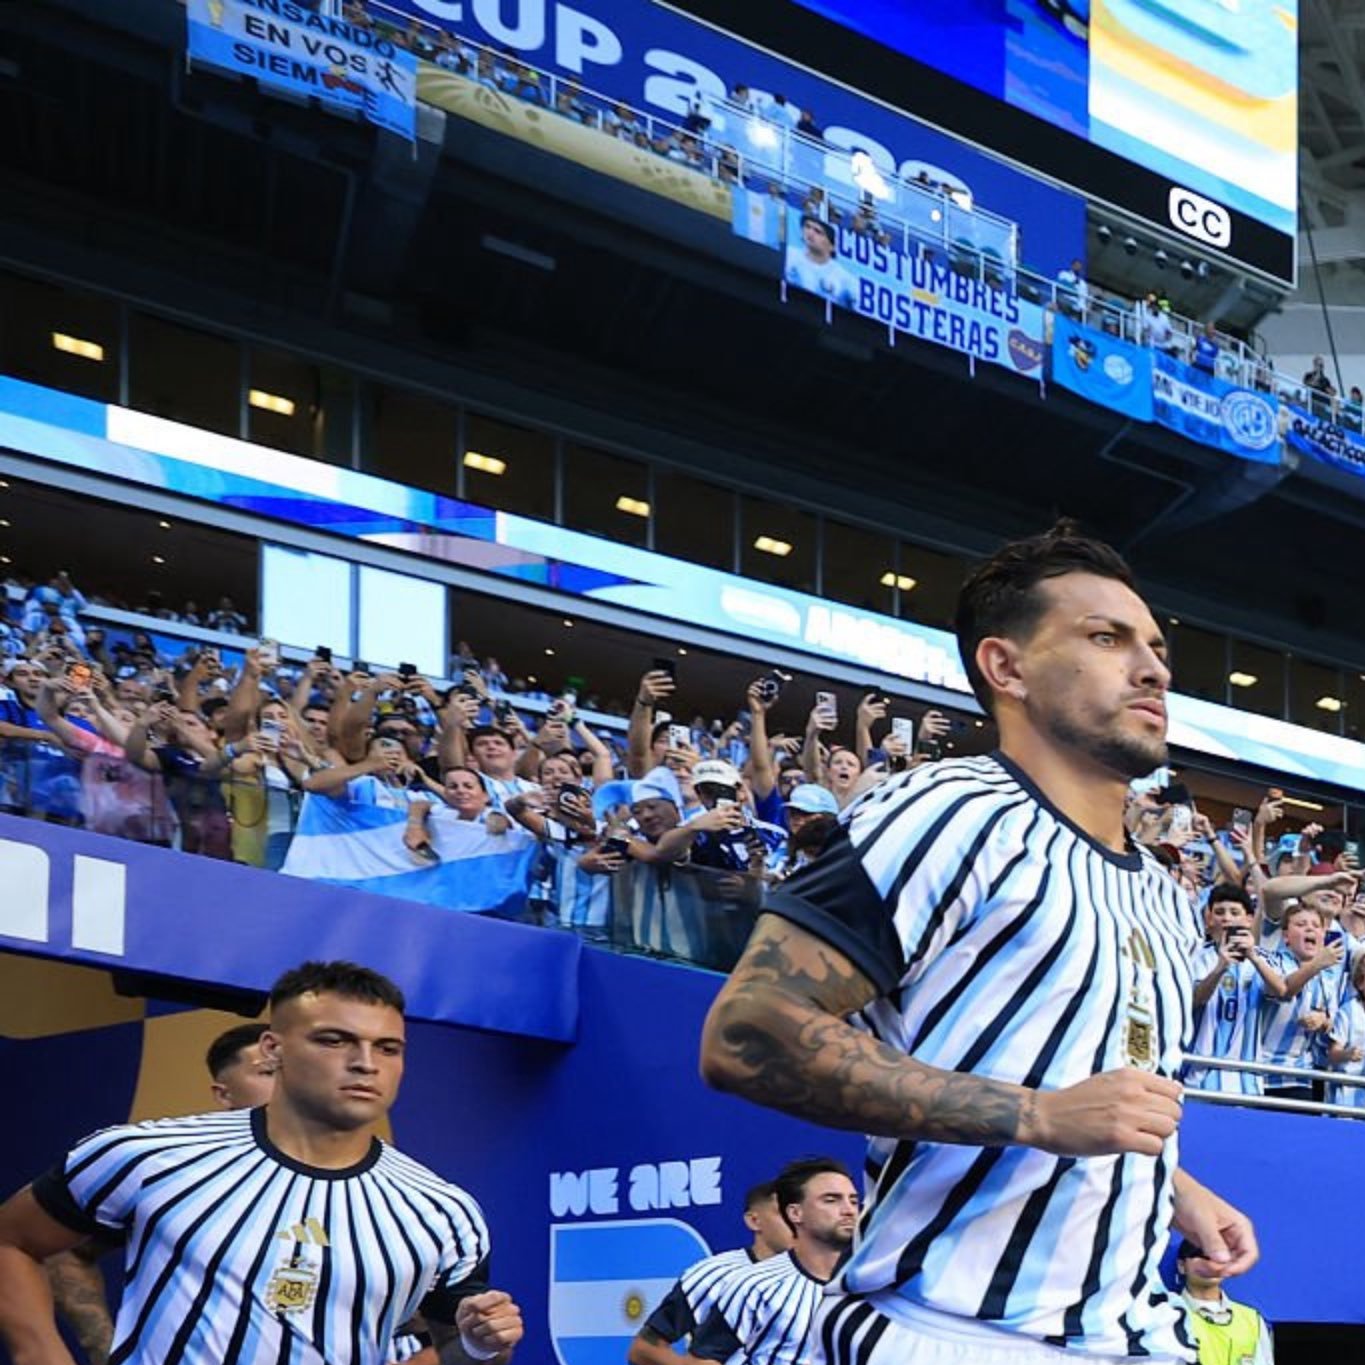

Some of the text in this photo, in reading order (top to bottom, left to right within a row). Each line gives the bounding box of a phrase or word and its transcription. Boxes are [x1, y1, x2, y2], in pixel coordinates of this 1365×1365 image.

[244, 14, 368, 73] EN VOS
[1178, 198, 1222, 239] CC
[836, 224, 1020, 325] COSTUMBRES
[858, 276, 1000, 359] BOSTERAS
[549, 1167, 620, 1218] WE
